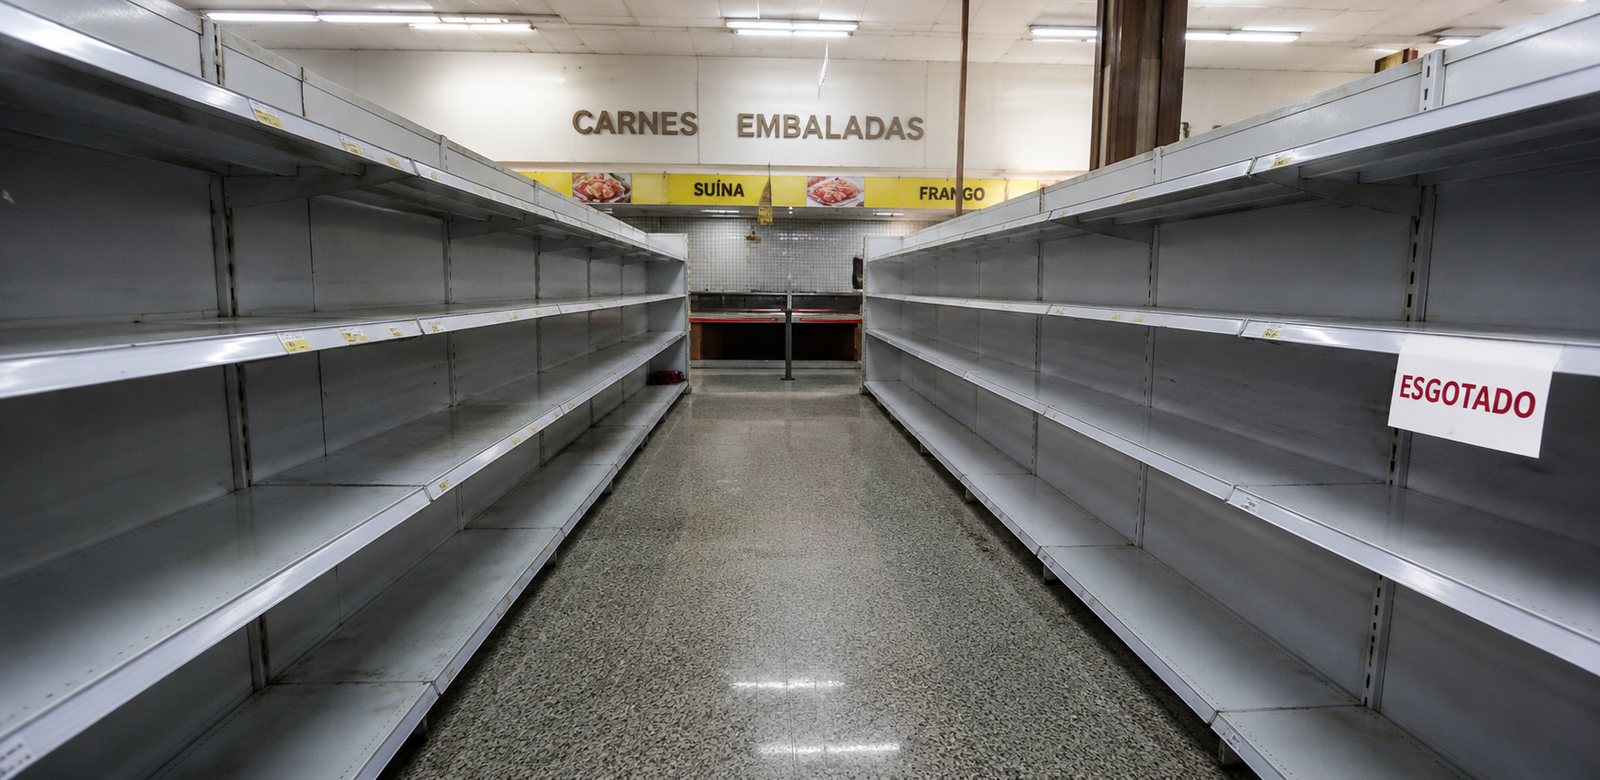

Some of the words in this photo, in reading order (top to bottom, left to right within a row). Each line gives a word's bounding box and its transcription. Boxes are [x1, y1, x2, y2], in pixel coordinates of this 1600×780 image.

[572, 110, 698, 136] CARNES
[737, 113, 925, 141] EMBALADAS
[693, 179, 745, 197] SUÍNA
[1399, 374, 1536, 419] ESGOTADO
